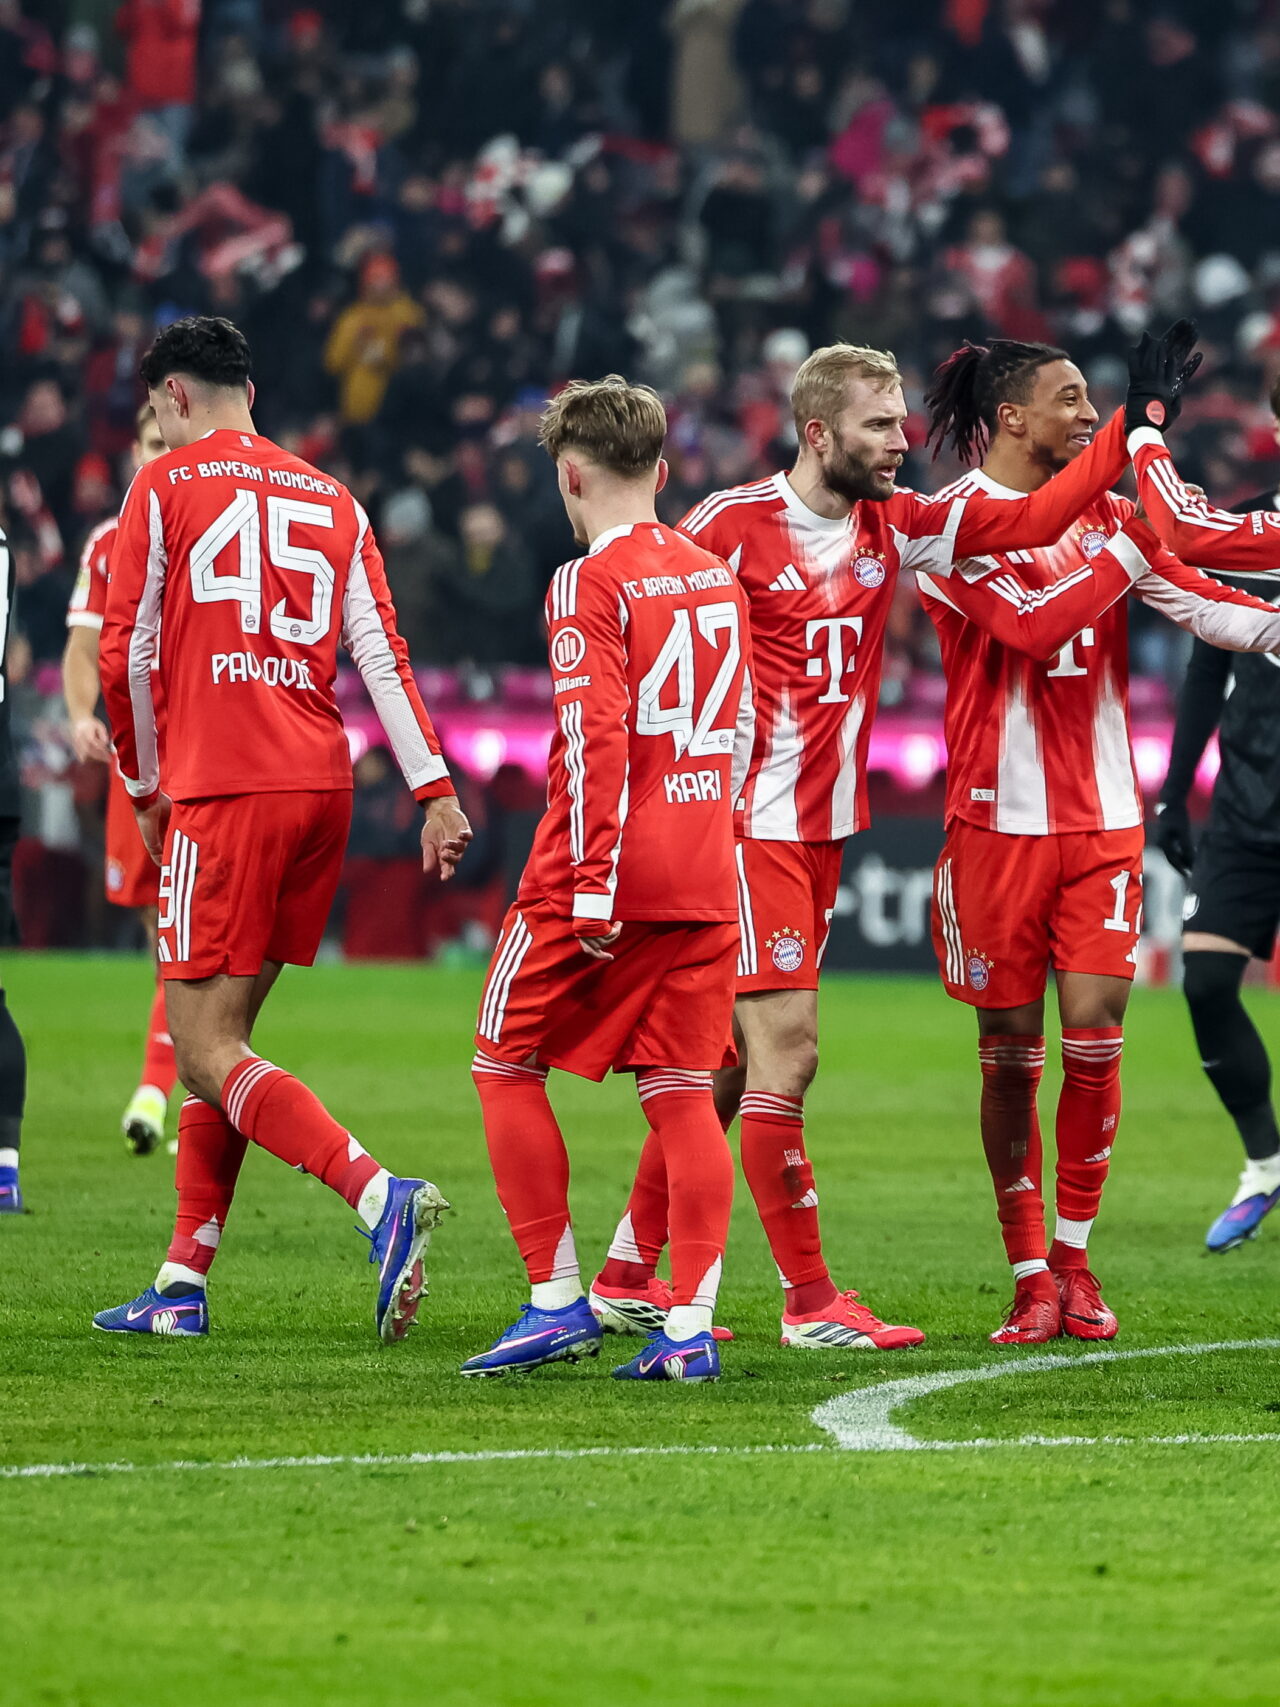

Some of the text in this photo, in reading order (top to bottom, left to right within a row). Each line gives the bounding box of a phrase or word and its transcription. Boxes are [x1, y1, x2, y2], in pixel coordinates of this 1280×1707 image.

[168, 461, 340, 497] FC BAYERN MÜNCHEN
[189, 488, 335, 646] 45
[622, 580, 644, 600] FC
[641, 575, 688, 597] BAYERN
[554, 675, 592, 695] Allianz
[636, 601, 741, 763] 42
[663, 769, 722, 804] KARI
